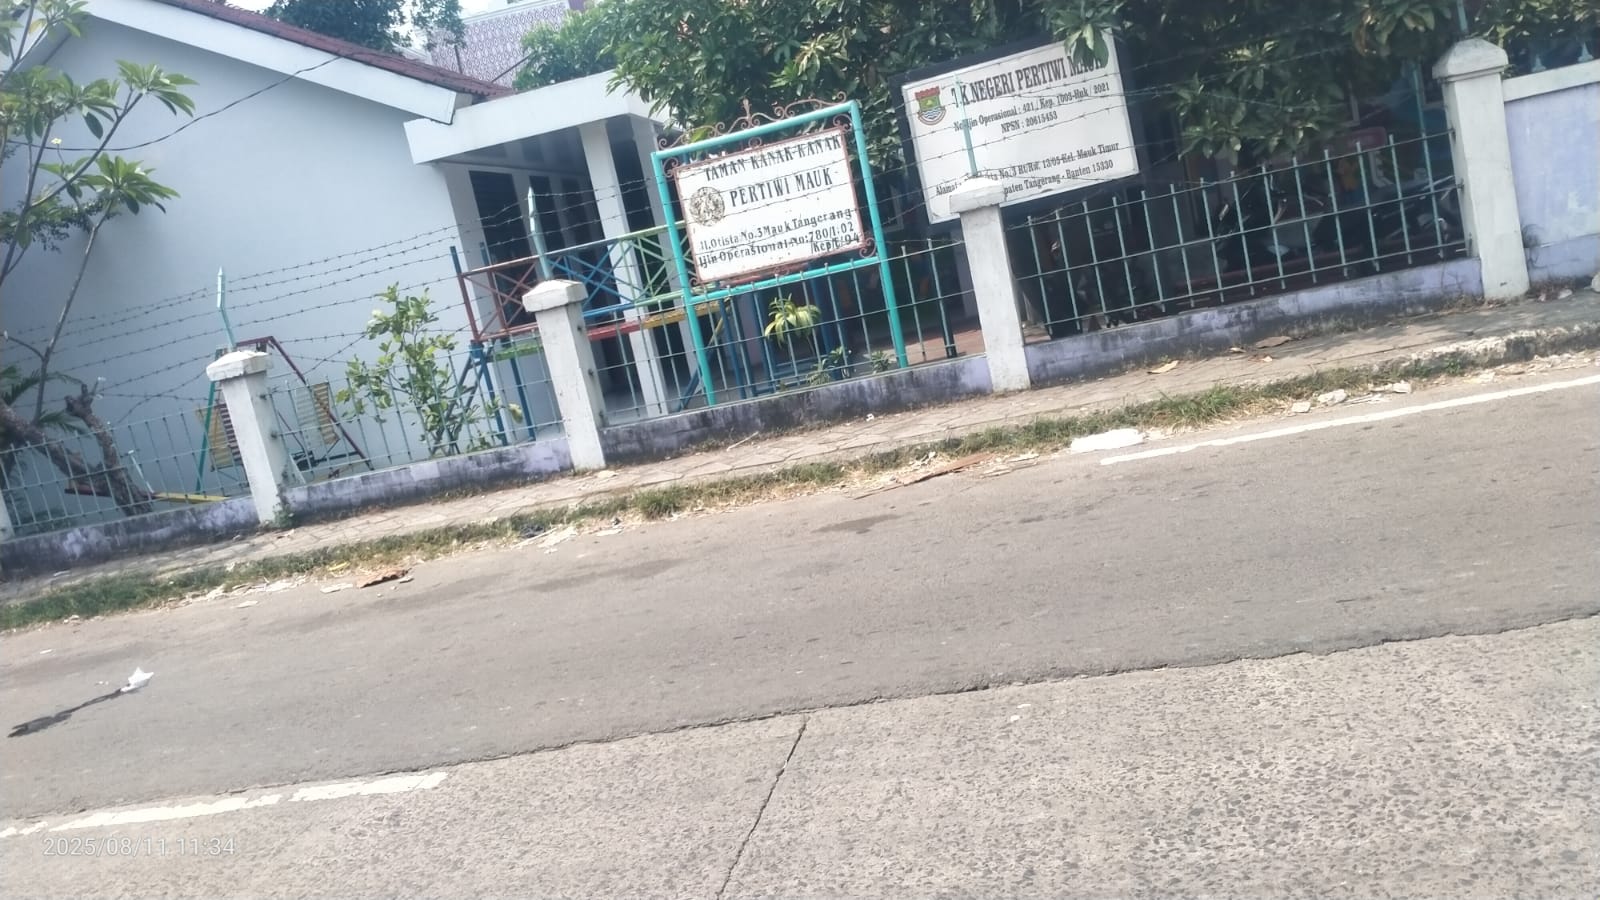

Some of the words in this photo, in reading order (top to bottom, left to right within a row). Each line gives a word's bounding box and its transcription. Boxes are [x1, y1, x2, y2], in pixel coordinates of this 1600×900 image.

[969, 71, 1015, 104] NEGERI
[1015, 57, 1068, 91] PERTIWI
[978, 105, 1018, 127] Operasional
[1023, 101, 1035, 112] 421
[1094, 82, 1110, 94] 2021
[1000, 119, 1020, 133] NPSN
[1097, 142, 1119, 154] Timur
[705, 158, 747, 182] TAMAN
[1065, 166, 1091, 179] Banten
[1092, 159, 1113, 172] 15330
[730, 177, 789, 207] PERTIWI
[794, 167, 833, 192] MAUK
[792, 208, 852, 230] Tangerang
